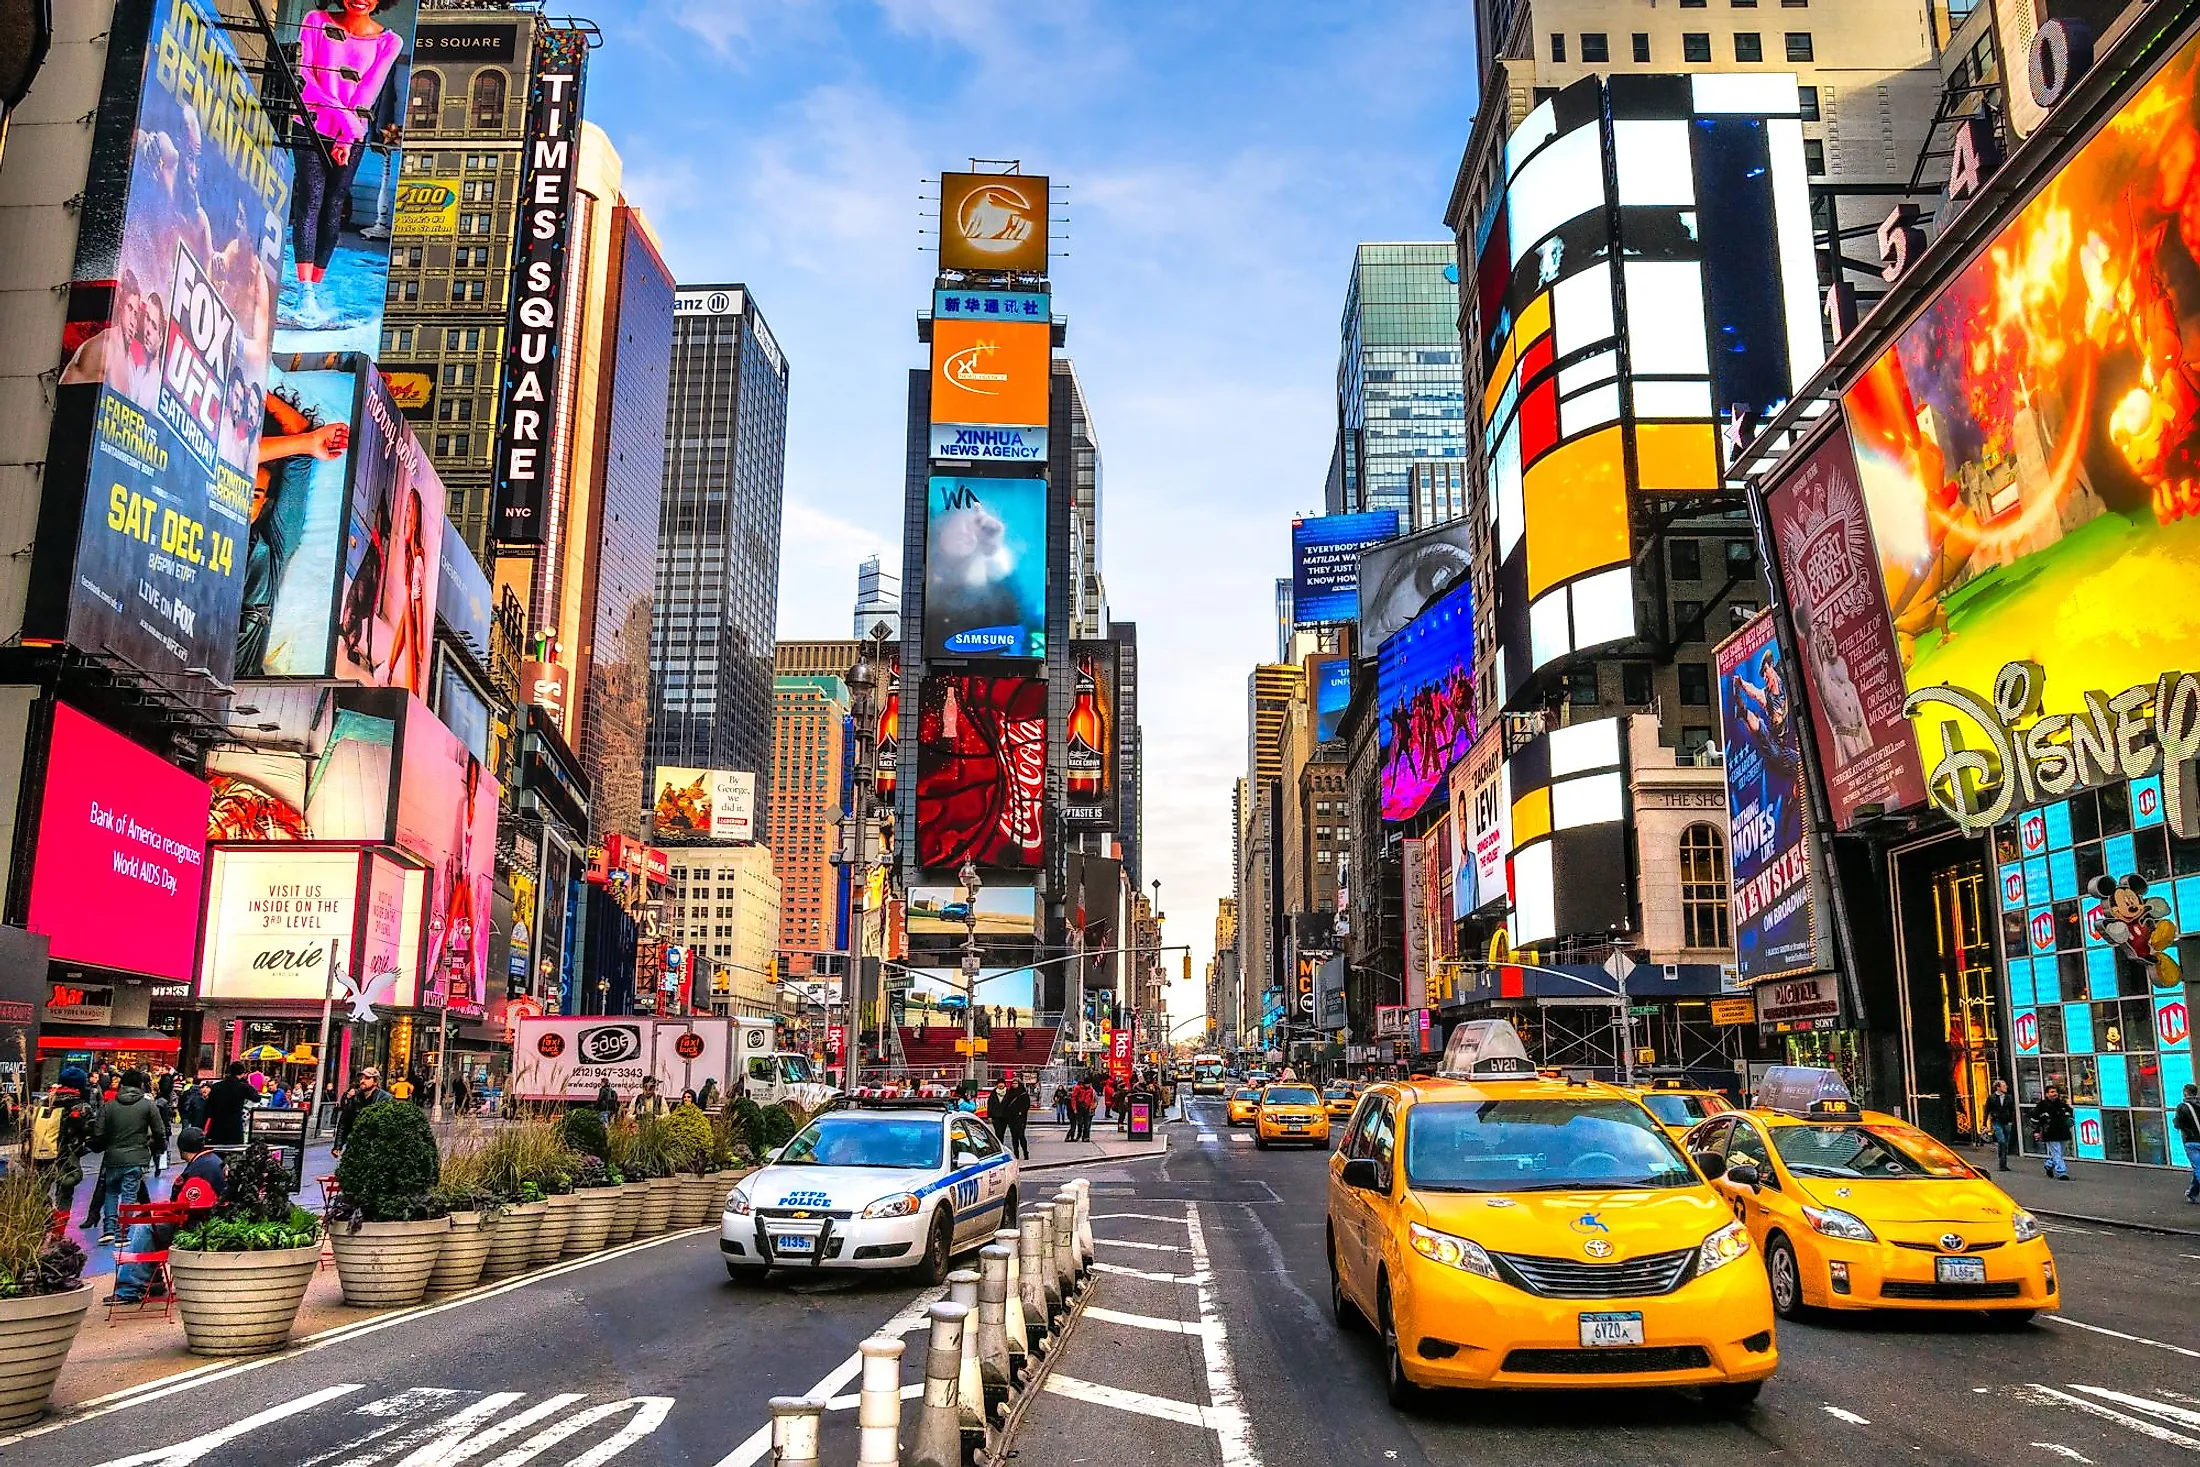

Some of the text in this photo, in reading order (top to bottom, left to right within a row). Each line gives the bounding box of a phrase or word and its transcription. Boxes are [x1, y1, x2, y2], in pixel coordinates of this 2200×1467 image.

[439, 37, 501, 48] SQUARE
[156, 26, 288, 216] BENAVIDEZ
[532, 75, 574, 239] TIMES
[259, 210, 282, 284] 2
[172, 248, 233, 383] FOX
[945, 297, 1039, 316] 新华通讯社
[509, 261, 554, 480] SQUARE
[167, 334, 221, 432] UFC
[105, 395, 145, 433] FABER
[366, 386, 397, 460] merry
[160, 388, 216, 466] SATURDAY
[955, 430, 1024, 446] XINHUA
[940, 445, 1039, 458] NEWS AGENCY
[505, 507, 532, 518] NYC
[108, 483, 157, 546] SAT.
[161, 508, 206, 566] DEC.
[208, 530, 234, 577] 14
[1303, 556, 1340, 565] MATILDA
[1807, 532, 1842, 581] GREAT
[1307, 566, 1330, 575] THEY
[1332, 564, 1354, 573] JUST
[1809, 553, 1848, 604] COMET
[1306, 576, 1335, 586] KNOW
[138, 577, 197, 638] LIVE ON FOX
[955, 633, 1015, 646] SAMSUNG
[717, 784, 750, 795] George,
[721, 803, 735, 812] did
[1475, 779, 1499, 837] LEVI
[1663, 794, 1690, 806] THE
[1094, 808, 1103, 817] IS
[90, 801, 202, 866] Bank of America recognizes
[1732, 803, 1776, 867] MOVES
[1760, 838, 1777, 864] LIKE
[113, 850, 178, 896] World AIDS Day.
[269, 885, 322, 898] VISIT US
[248, 900, 339, 913] INSIDE ON THE
[262, 915, 322, 928] 3RD LEVEL
[1762, 910, 1775, 933] ON
[253, 941, 324, 970] aerie
[1959, 995, 1996, 1008] MAC
[1814, 1018, 1835, 1029] SONY
[590, 1035, 629, 1054] edge
[1115, 1031, 1127, 1059] tkts
[572, 1067, 643, 1078] (212) 947-3343
[1823, 1101, 1847, 1112] 7L66
[778, 1197, 832, 1208] POLICE
[957, 1177, 979, 1211] NYPD
[780, 1235, 805, 1248] 4135
